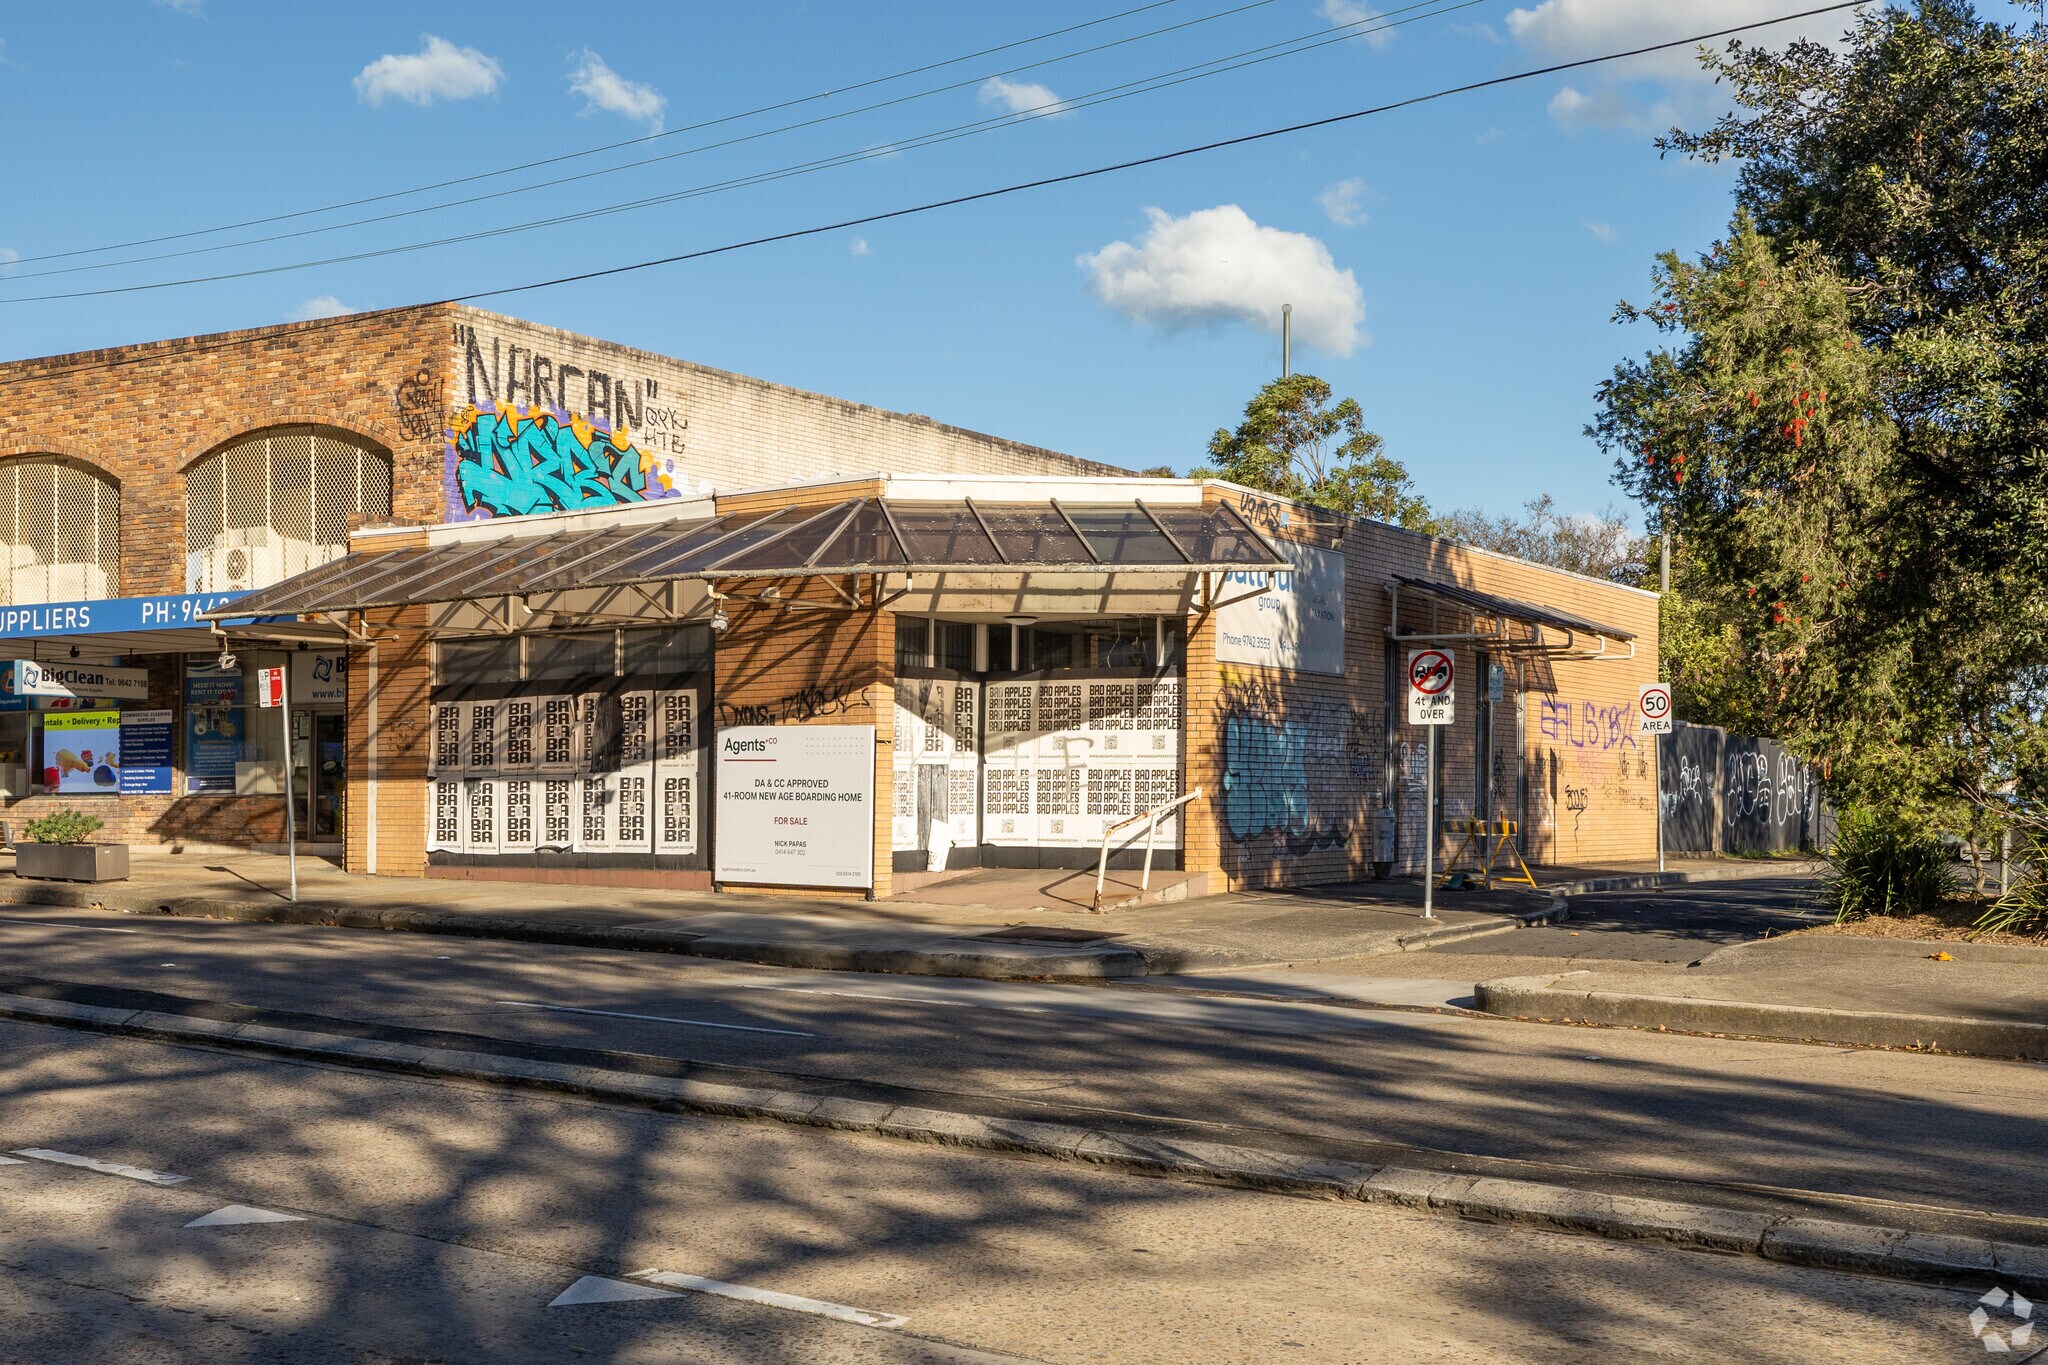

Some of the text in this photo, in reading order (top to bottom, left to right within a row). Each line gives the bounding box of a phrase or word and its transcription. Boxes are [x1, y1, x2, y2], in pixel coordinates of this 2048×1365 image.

[1258, 596, 1281, 613] group
[142, 601, 177, 624] PH:
[1222, 632, 1242, 646] Phone
[1242, 634, 1256, 648] 9742
[1256, 636, 1271, 650] 3553
[41, 668, 148, 688] BigClean Tel: 9642 7188
[955, 687, 973, 700] BA
[1039, 685, 1081, 696] BAD APPLES
[1090, 684, 1134, 695] BAD APPLES
[1137, 683, 1182, 695] BAD APPLES
[665, 696, 691, 707] BA
[1004, 698, 1031, 708] APPLES
[1039, 697, 1081, 708] BAD APPLES
[1090, 696, 1134, 707] BAD APPLES
[1137, 695, 1182, 706] BAD APPLES
[1414, 695, 1451, 706] 4t AND
[1645, 696, 1667, 712] 50
[439, 707, 460, 718] BA
[472, 706, 495, 718] BA
[508, 703, 531, 715] BA
[546, 701, 570, 713] BA
[955, 701, 973, 713] BA
[1137, 707, 1182, 718] BAD APPLES
[665, 709, 691, 721] BA
[1039, 709, 1081, 719] BAD APPLES
[1089, 708, 1134, 718] BAD APPLES
[1420, 709, 1445, 720] OVER
[72, 717, 101, 728] Delivery
[439, 719, 460, 730] BA
[472, 718, 494, 729] BA
[508, 715, 531, 727] BA
[546, 714, 570, 725] BA
[1089, 719, 1133, 730] BAD APPLES
[1137, 719, 1181, 730] BAD APPLES
[1003, 721, 1031, 731] APPLES
[1038, 720, 1081, 731] BAD APPLES
[1641, 720, 1671, 731] AREA
[546, 738, 570, 750] BA
[665, 735, 691, 746] BA
[955, 740, 973, 752] BA
[438, 742, 459, 754] BA
[438, 754, 459, 766] BA
[472, 754, 493, 766] BA
[508, 752, 531, 764] BA
[546, 751, 570, 762] BA
[1088, 769, 1131, 781] BAD APPLES
[1134, 769, 1180, 781] BAD APPLES
[437, 783, 458, 794] BA
[508, 781, 531, 792] BA
[665, 778, 691, 790] BA
[754, 779, 829, 788] DA & CC APPROVED
[987, 781, 1029, 791] BAD APPLES
[1134, 781, 1180, 792] BAD APPLES
[437, 795, 458, 806] BA
[508, 794, 531, 804] BA
[665, 792, 691, 803] BA
[723, 791, 863, 802] 41-ROOM NEW AGE BOARDING HOME
[987, 792, 1029, 803] BAD APPLES
[987, 803, 1029, 814] BAD APPLES
[1037, 803, 1079, 815] BAD APPLES
[1088, 803, 1131, 815] BAD APPLES
[546, 818, 569, 829] BA
[774, 816, 808, 826] FOR SALE
[437, 831, 458, 842] BA
[508, 830, 531, 842] BA
[546, 830, 569, 842] BA
[774, 840, 807, 848] NICK PAPAS
